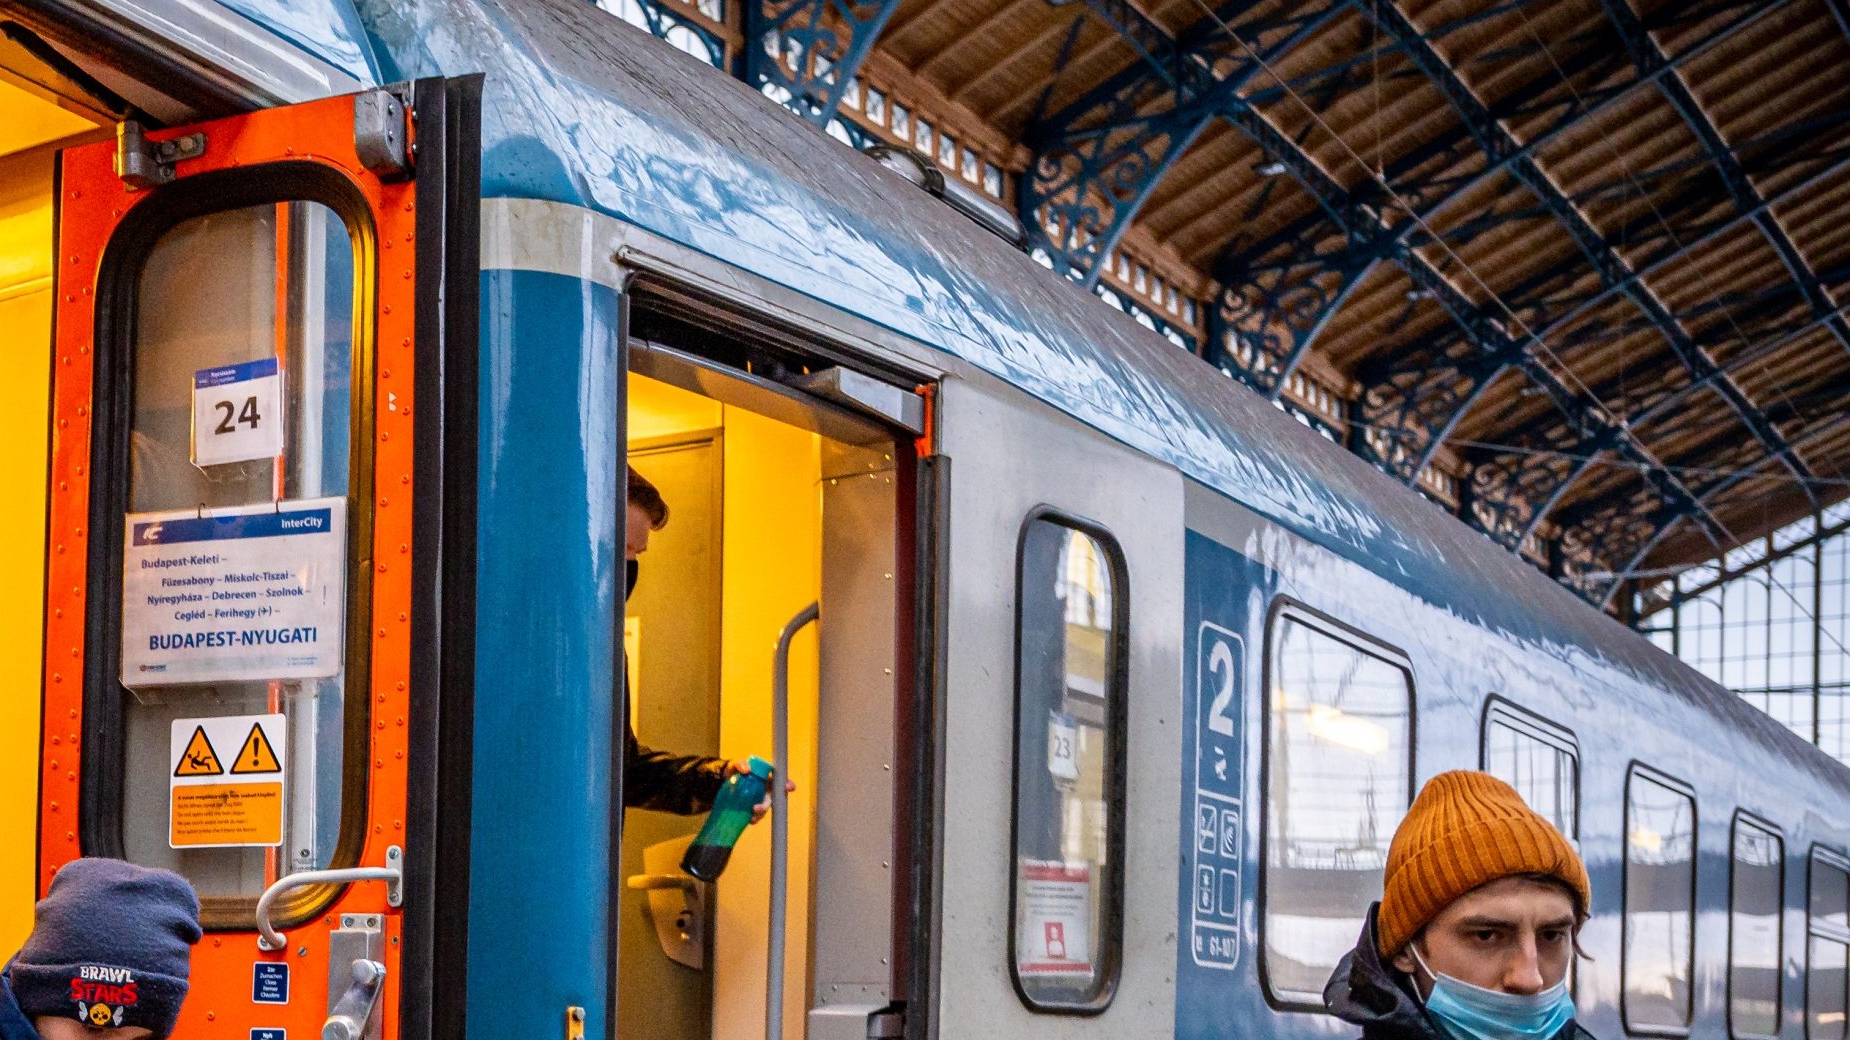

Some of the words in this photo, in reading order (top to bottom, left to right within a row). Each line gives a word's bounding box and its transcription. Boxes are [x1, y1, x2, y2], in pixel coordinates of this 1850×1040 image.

[215, 396, 261, 435] 24
[281, 516, 323, 529] InterCity
[141, 554, 219, 569] Budapest-Keleti
[161, 574, 215, 587] Füzesabony
[224, 571, 289, 583] Miskolc-Tiszai
[147, 593, 202, 606] Nyíregyháza
[212, 590, 257, 601] Debrecen
[266, 587, 303, 598] Szolnok
[174, 609, 206, 622] Cegléd
[214, 607, 256, 620] Ferihegy
[149, 627, 317, 650] BUDAPEST-NYUGATI
[1208, 639, 1234, 737] 2
[1054, 734, 1071, 760] 23
[79, 965, 135, 983] BRAWL
[70, 977, 139, 1006] STARS
